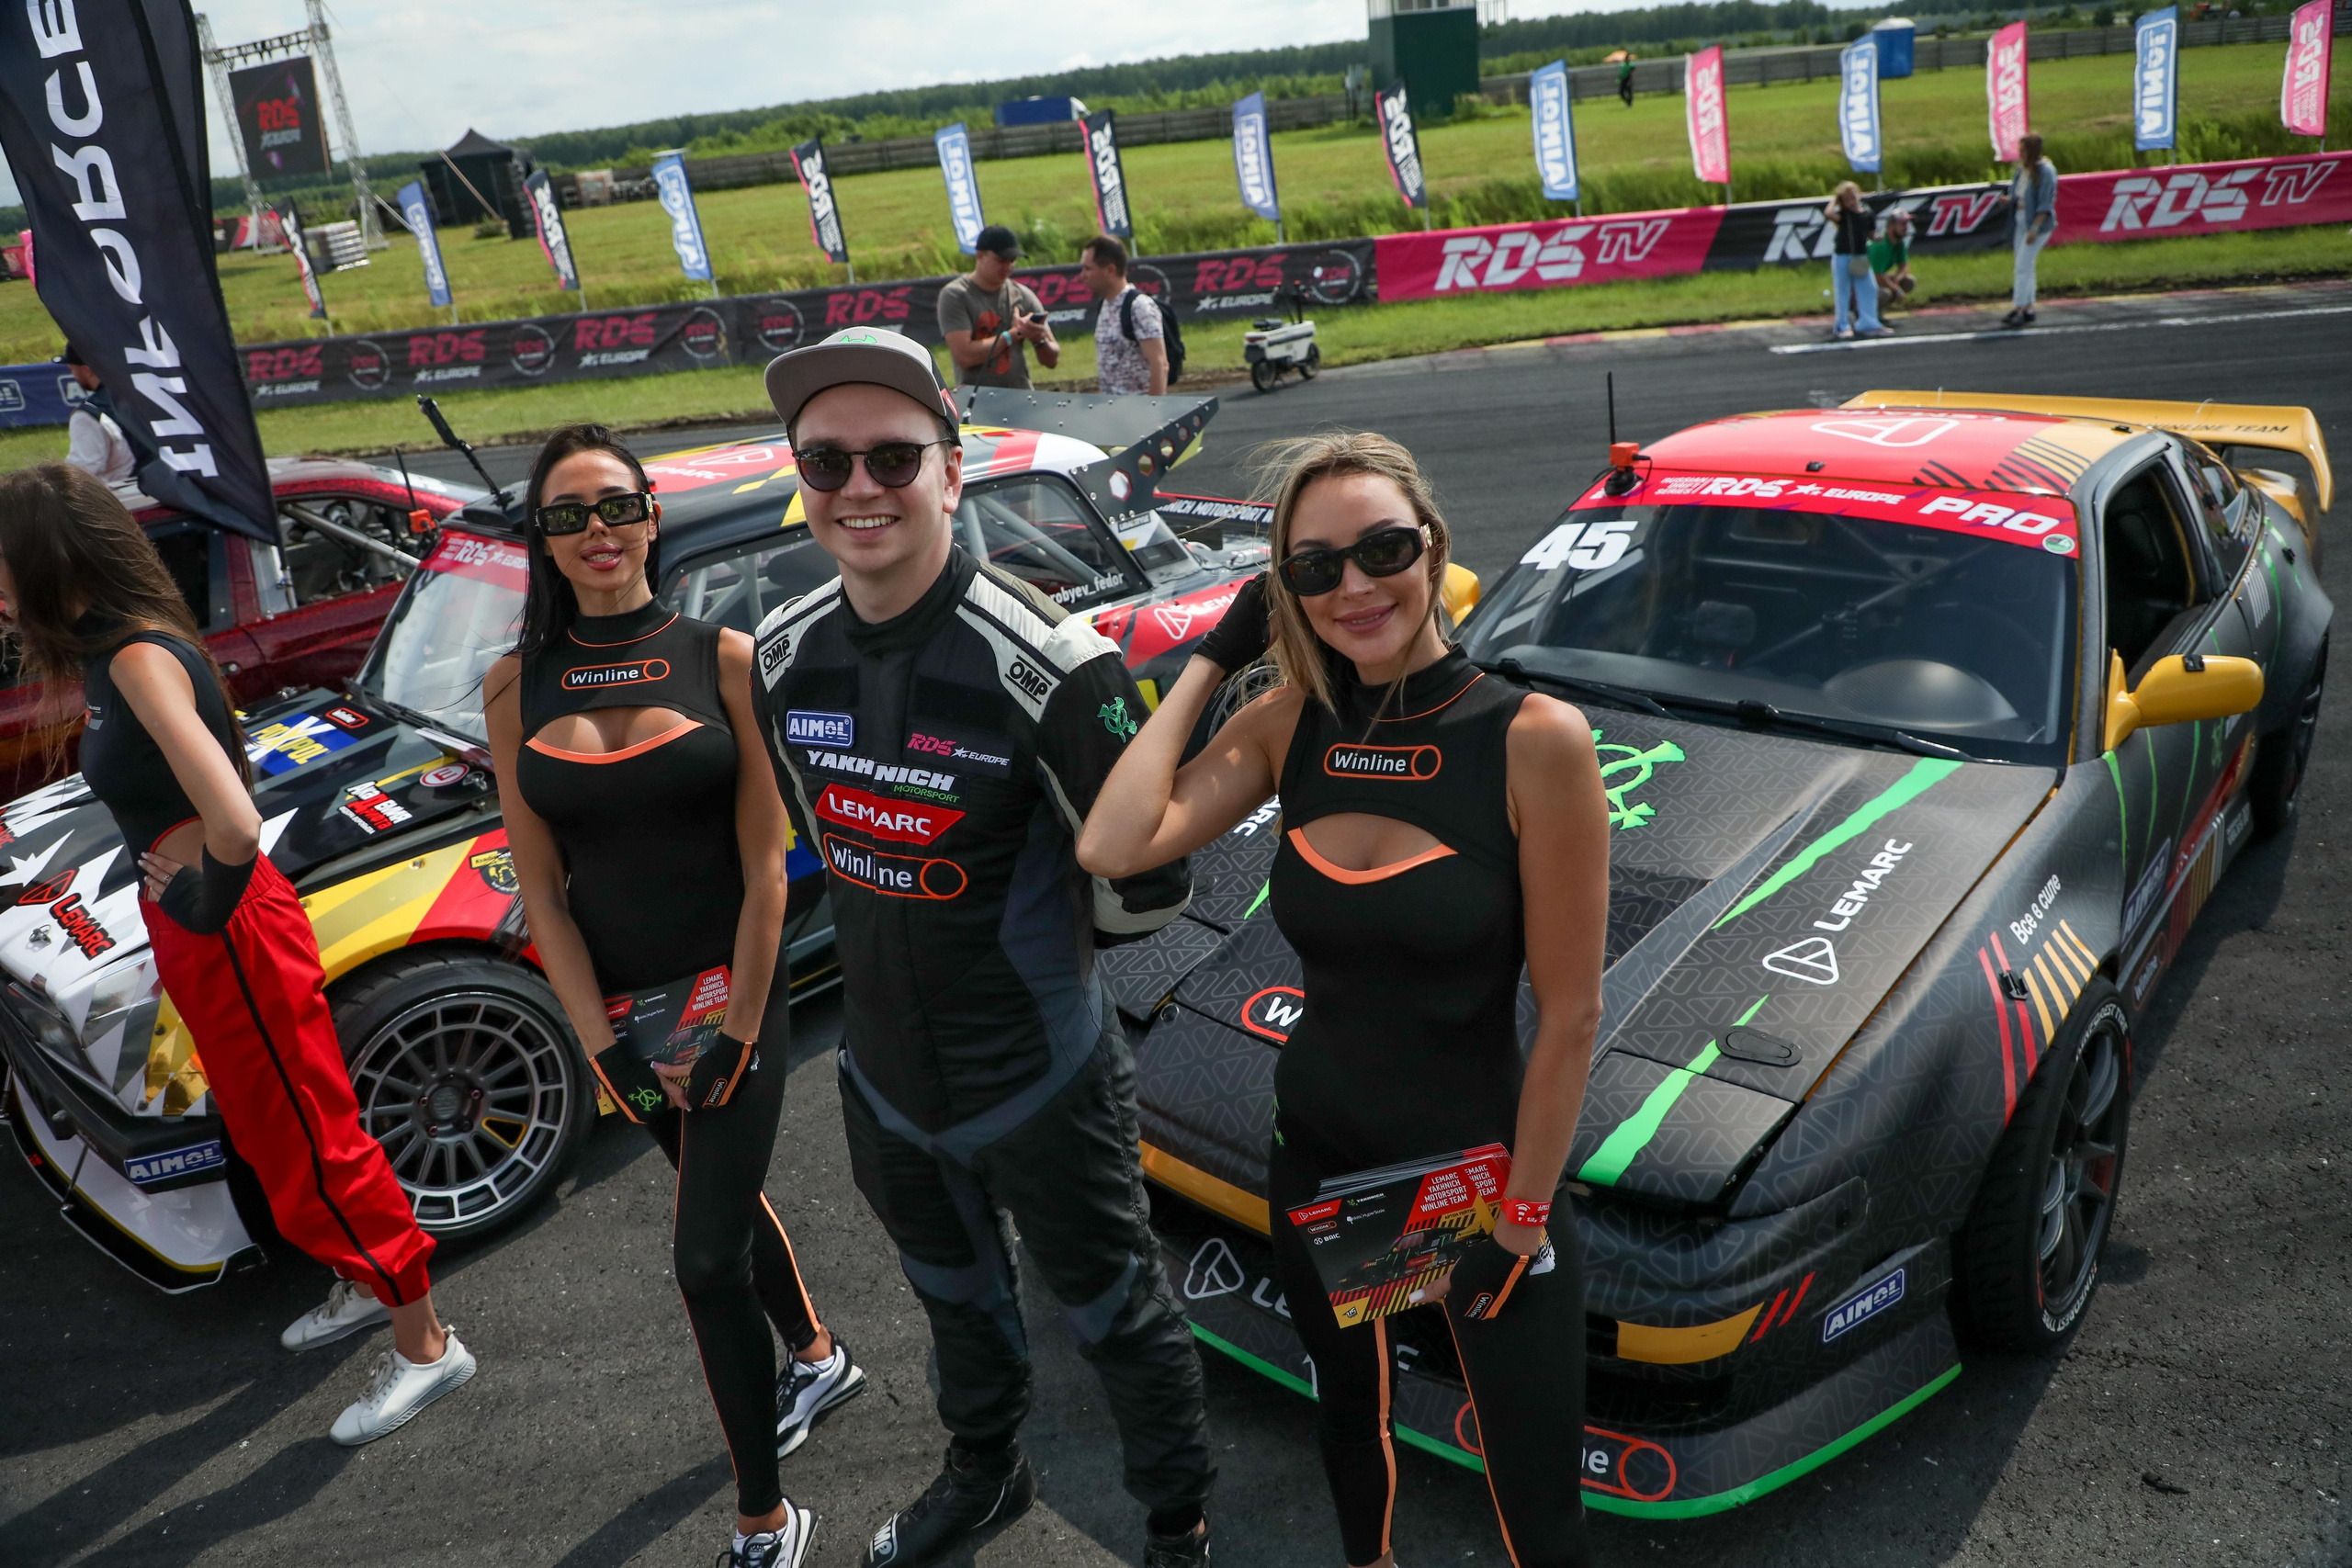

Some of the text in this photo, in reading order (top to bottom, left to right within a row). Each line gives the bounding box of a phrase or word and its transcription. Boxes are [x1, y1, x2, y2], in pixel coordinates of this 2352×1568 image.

[257, 96, 301, 130] RDS
[2099, 160, 2341, 233] RDS TV
[1927, 190, 2004, 236] TV
[1434, 219, 1672, 290] RDS TV
[1193, 254, 1290, 293] RDS
[825, 287, 913, 324] RDS
[574, 312, 659, 350] RDS
[247, 344, 322, 381] RDS
[408, 330, 486, 366] RDS
[2233, 424, 2290, 434] TEAM
[1700, 477, 1906, 506] RDS EUROPE
[1193, 502, 1263, 523] MOTORSPORT
[1918, 495, 2061, 536] PRO
[454, 540, 497, 567] RDS
[1520, 520, 1638, 571] 45
[1051, 571, 1125, 604] robyev_fedor
[1193, 592, 1238, 615] LEMA
[763, 639, 791, 671] OMP
[571, 669, 639, 684] Winline
[1010, 661, 1048, 702] OMP
[787, 716, 850, 741] AIMOL
[907, 732, 1010, 767] RDS EUROPE
[1333, 750, 1407, 773] Winline
[807, 750, 955, 792] YAKHNICH
[893, 784, 960, 803] MOTORSPORT
[829, 793, 931, 837] LEMARC
[1233, 794, 1282, 837] ARC
[830, 841, 912, 888] Winline
[1814, 839, 1914, 931] LEMARC
[2009, 874, 2062, 945] Все в силе
[51, 893, 114, 957] LEMARC
[698, 980, 725, 994] YAKHNICH
[703, 972, 723, 985] LEMARC
[692, 995, 729, 1011] WINLINE TEAM
[695, 987, 729, 1002] MOTORSPORT
[708, 1080, 726, 1104] Winline
[130, 1145, 221, 1180] AIMOL
[1464, 1164, 1488, 1176] EMARC
[1427, 1179, 1461, 1193] YAKHNICH
[1431, 1172, 1459, 1185] LEMARC
[1475, 1177, 1497, 1190] SPORT
[1478, 1186, 1498, 1197] TEAM
[1420, 1193, 1468, 1213] WINLINE TEAM
[1424, 1185, 1467, 1203] MOTORSPORT
[1307, 1206, 1333, 1217] LEMARC
[1309, 1224, 1329, 1233] Winline
[1468, 1296, 1490, 1318] Winlin
[1827, 1277, 1902, 1336] AIMOL
